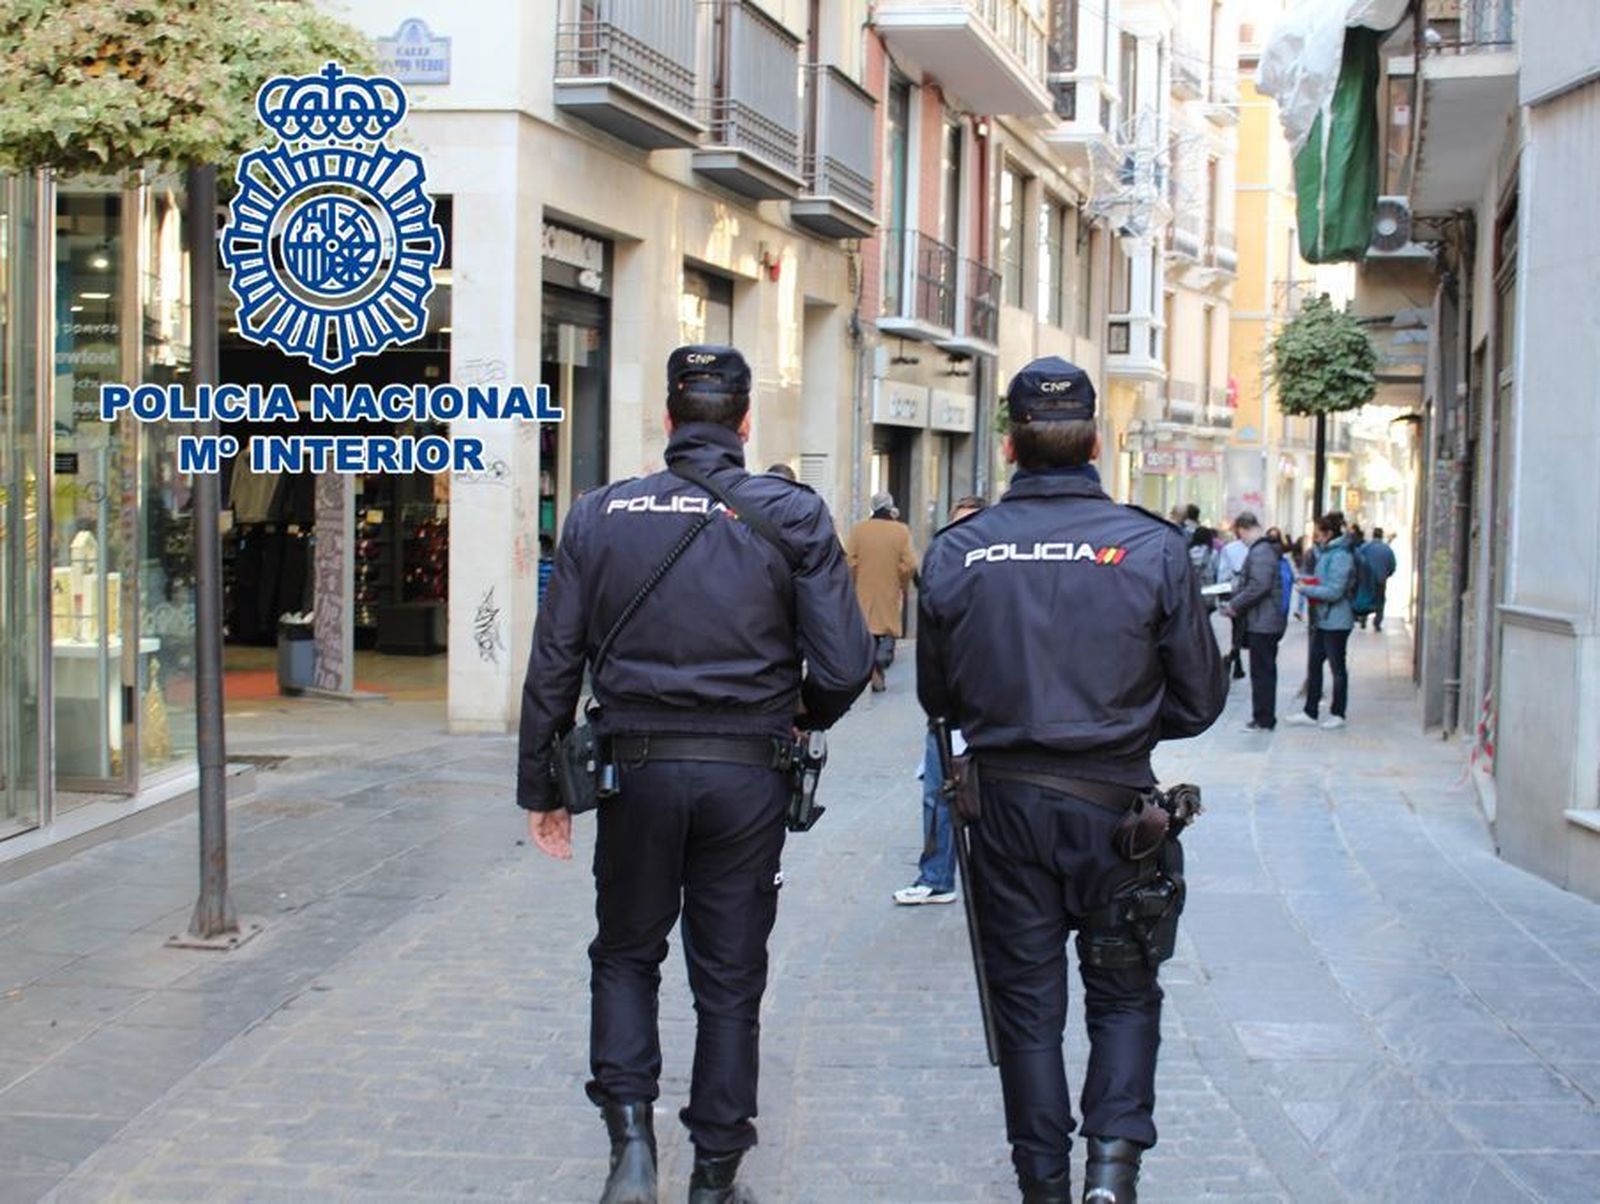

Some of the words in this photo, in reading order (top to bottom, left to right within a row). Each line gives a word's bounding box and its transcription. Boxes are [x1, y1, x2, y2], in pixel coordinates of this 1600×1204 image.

[686, 353, 716, 364] CNP
[1040, 380, 1071, 393] CNP
[964, 543, 1097, 568] POLICIA
